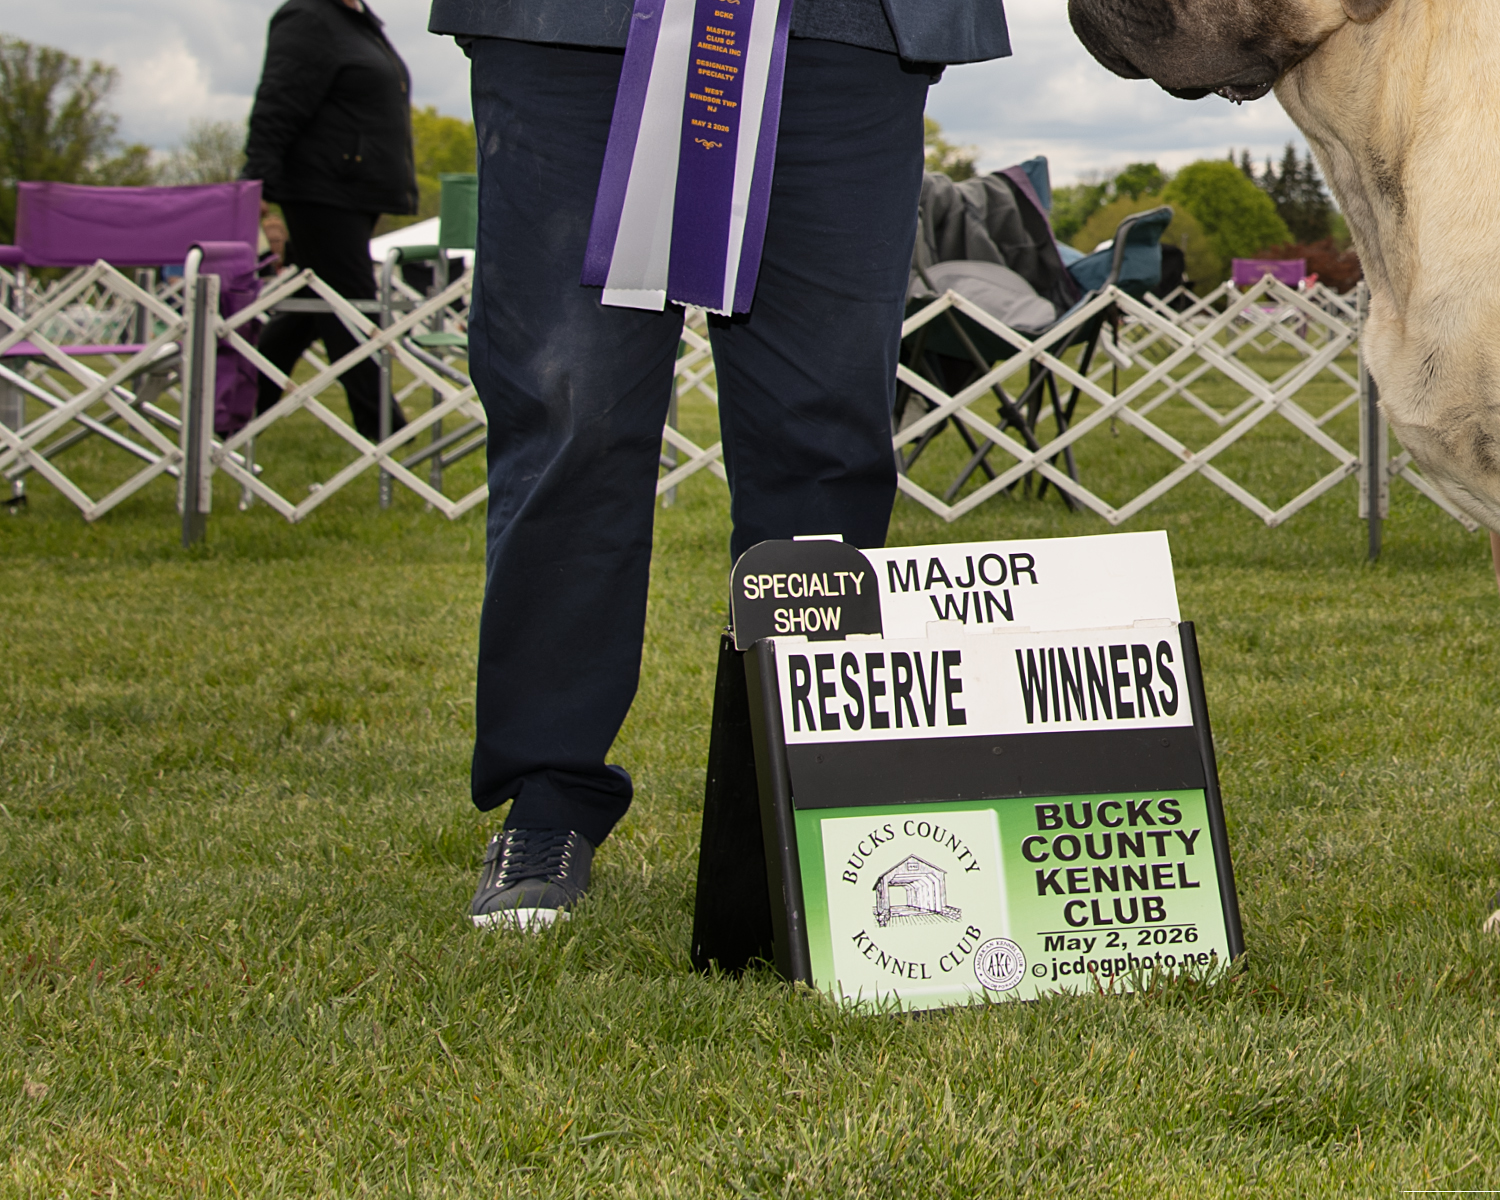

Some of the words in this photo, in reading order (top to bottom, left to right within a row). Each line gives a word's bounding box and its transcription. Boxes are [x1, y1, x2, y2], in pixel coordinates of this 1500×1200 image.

[714, 10, 734, 20] BCKC
[706, 25, 735, 37] MASTIFF
[706, 34, 724, 44] CLUB
[725, 38, 735, 46] OF
[697, 41, 728, 54] AMERICA
[729, 48, 741, 57] INC
[696, 58, 738, 74] DESIGNATED
[698, 68, 734, 81] SPECIALTY
[689, 92, 721, 105] WINDSOR
[722, 99, 738, 108] TWP
[704, 86, 724, 96] WEST
[707, 105, 718, 113] NJ
[691, 118, 706, 128] MAY
[707, 121, 712, 129] 2
[713, 123, 730, 133] 2026
[743, 571, 865, 600] SPECIALTY
[886, 552, 1039, 594] MAJOR
[774, 606, 841, 633] SHOW
[929, 589, 1015, 625] WIN
[788, 650, 967, 733] RESERVE
[1016, 640, 1179, 724] WINNERS
[1034, 798, 1183, 831] BUCKS
[842, 823, 895, 884] BUCKS
[903, 820, 981, 873] COUNTY
[1021, 828, 1201, 863] COUNTY
[1035, 862, 1201, 896] KENNEL
[1063, 896, 1167, 927] CLUB
[852, 929, 932, 980] KENNEL
[939, 925, 982, 972] CLUB
[1044, 935, 1097, 954] May
[1105, 931, 1128, 950] 2,
[1137, 927, 1199, 946] 2026
[976, 941, 994, 970] AMERICAN
[996, 940, 1018, 953] KENNEL
[987, 952, 1013, 977] AKC
